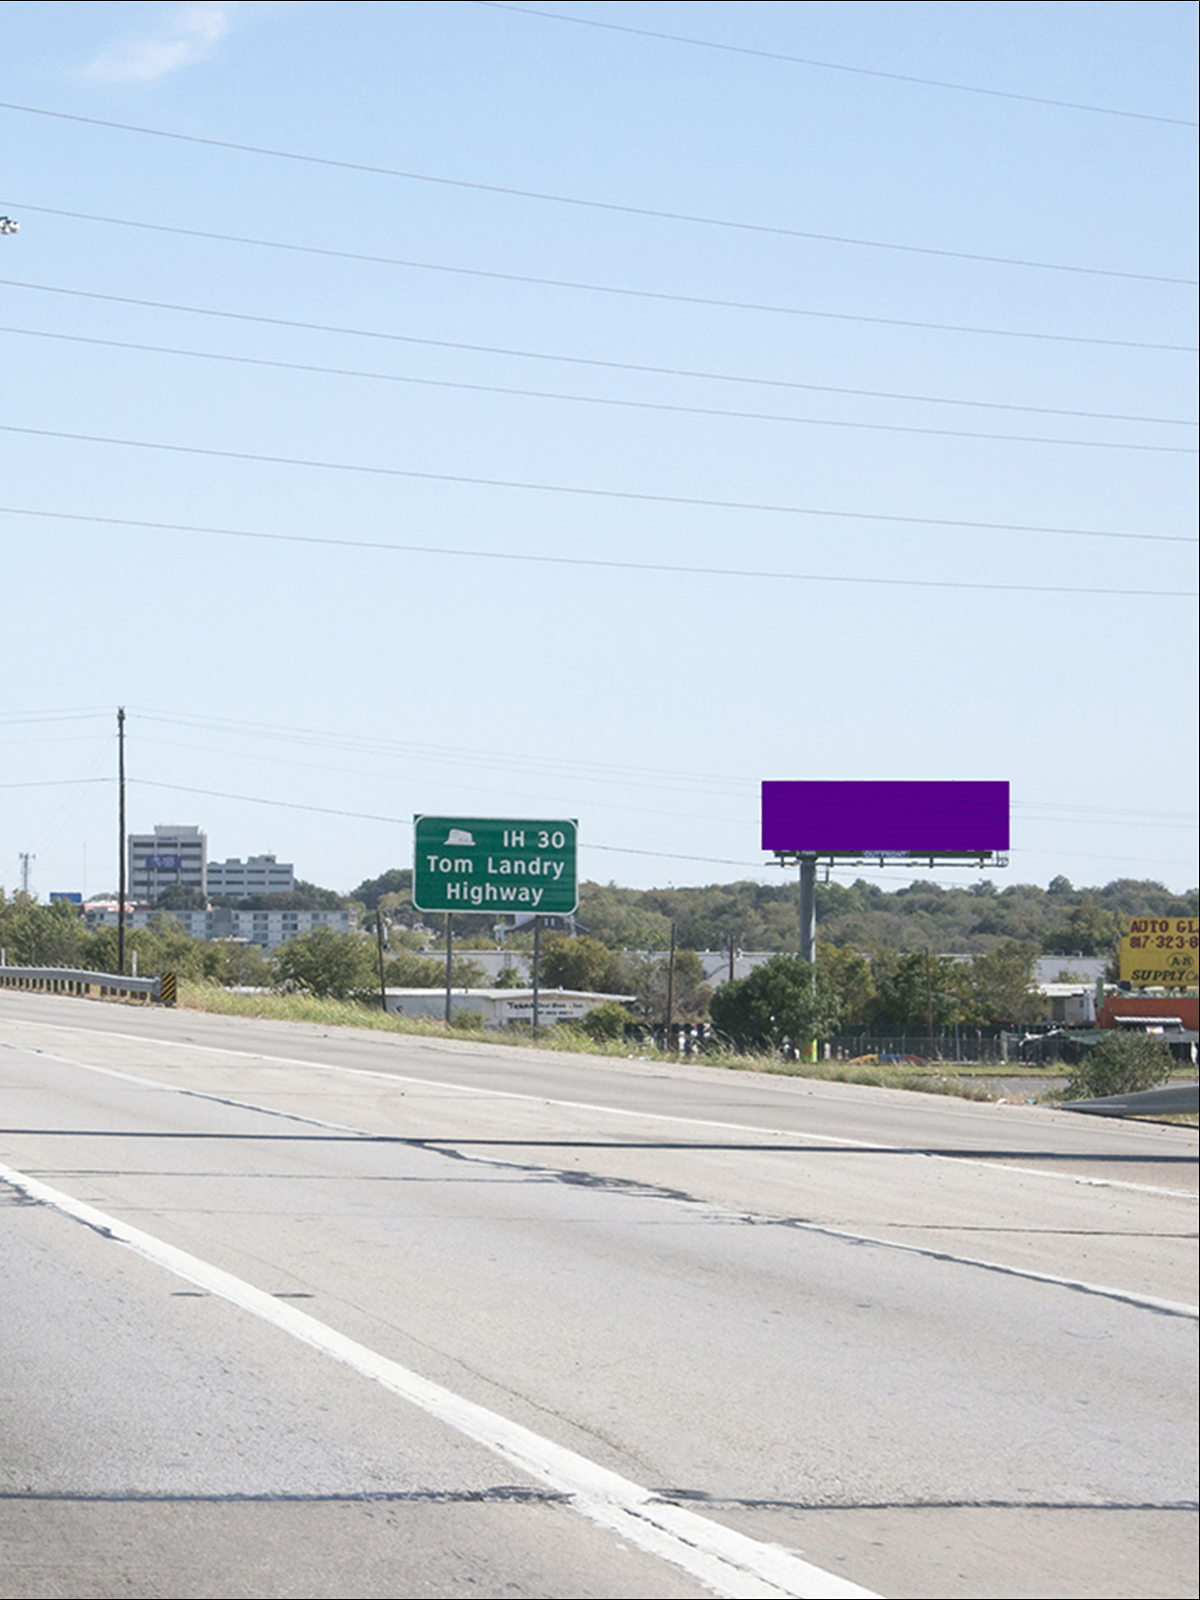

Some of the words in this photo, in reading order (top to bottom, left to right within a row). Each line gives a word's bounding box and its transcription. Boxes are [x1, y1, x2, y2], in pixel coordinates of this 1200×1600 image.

[503, 830, 525, 848] IH
[537, 831, 566, 849] 30
[427, 855, 473, 874] Tom
[487, 856, 565, 881] Landry
[446, 881, 543, 907] Highway
[1130, 919, 1169, 934] AUTO
[1131, 968, 1186, 981] SUPPLY
